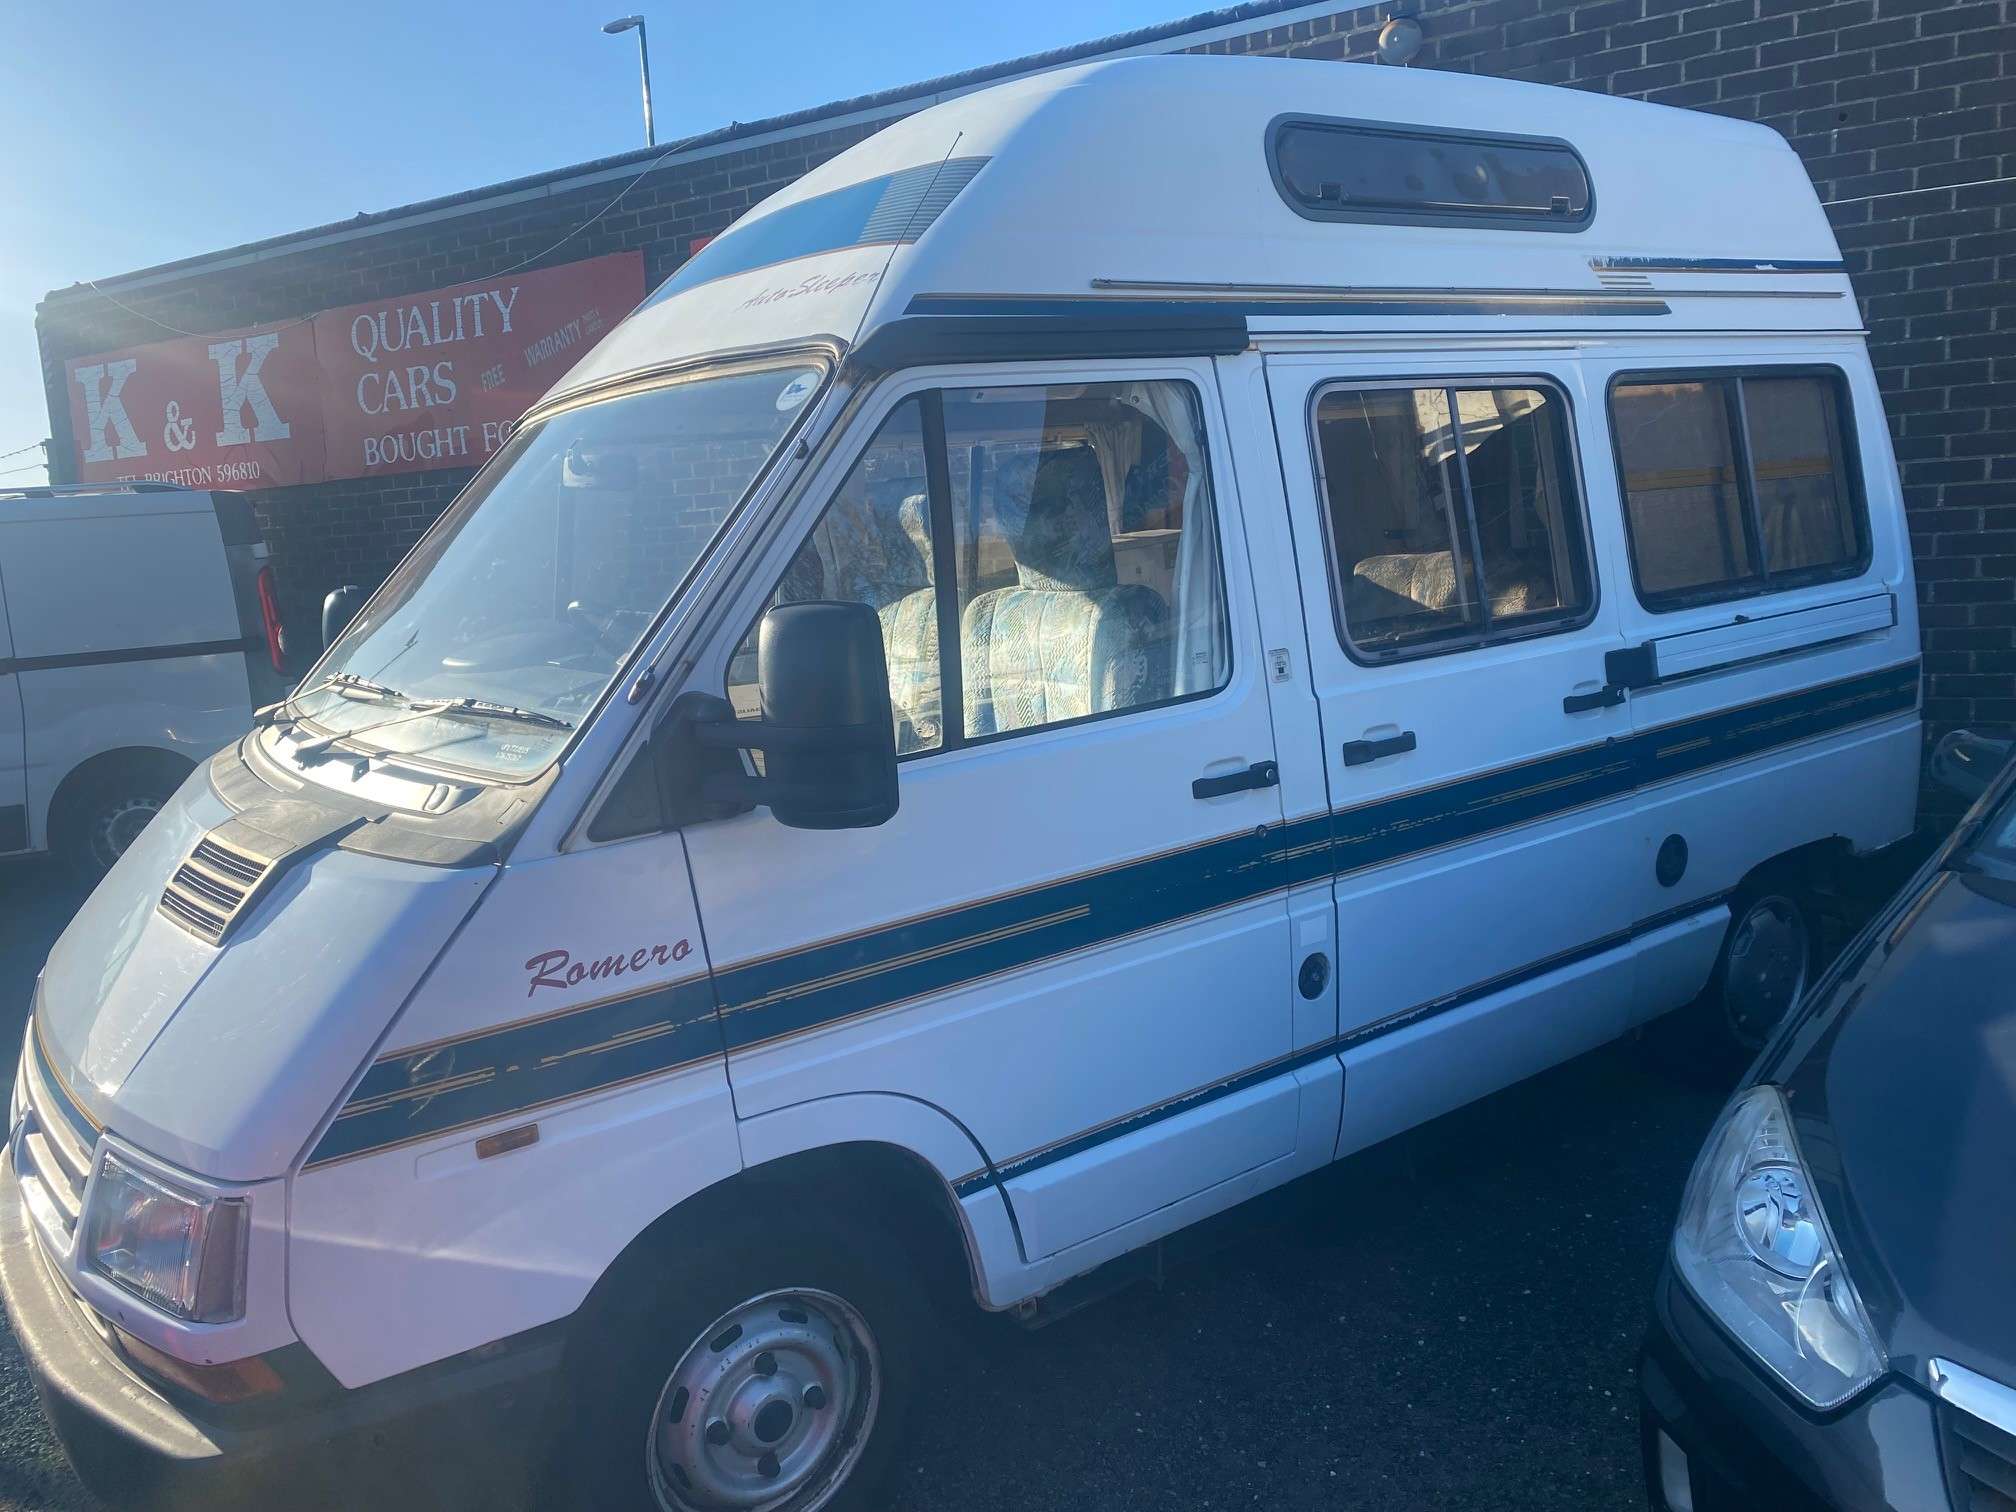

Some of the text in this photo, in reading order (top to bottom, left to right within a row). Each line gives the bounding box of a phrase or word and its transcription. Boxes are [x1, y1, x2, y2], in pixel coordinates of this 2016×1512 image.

[351, 287, 519, 362] QUALITY
[523, 319, 582, 368] WARRANTY
[74, 333, 291, 463] K & K
[357, 361, 457, 415] CARS
[363, 420, 514, 466] BOUGHT FO
[217, 460, 260, 483] 596810
[525, 938, 693, 998] Romero
